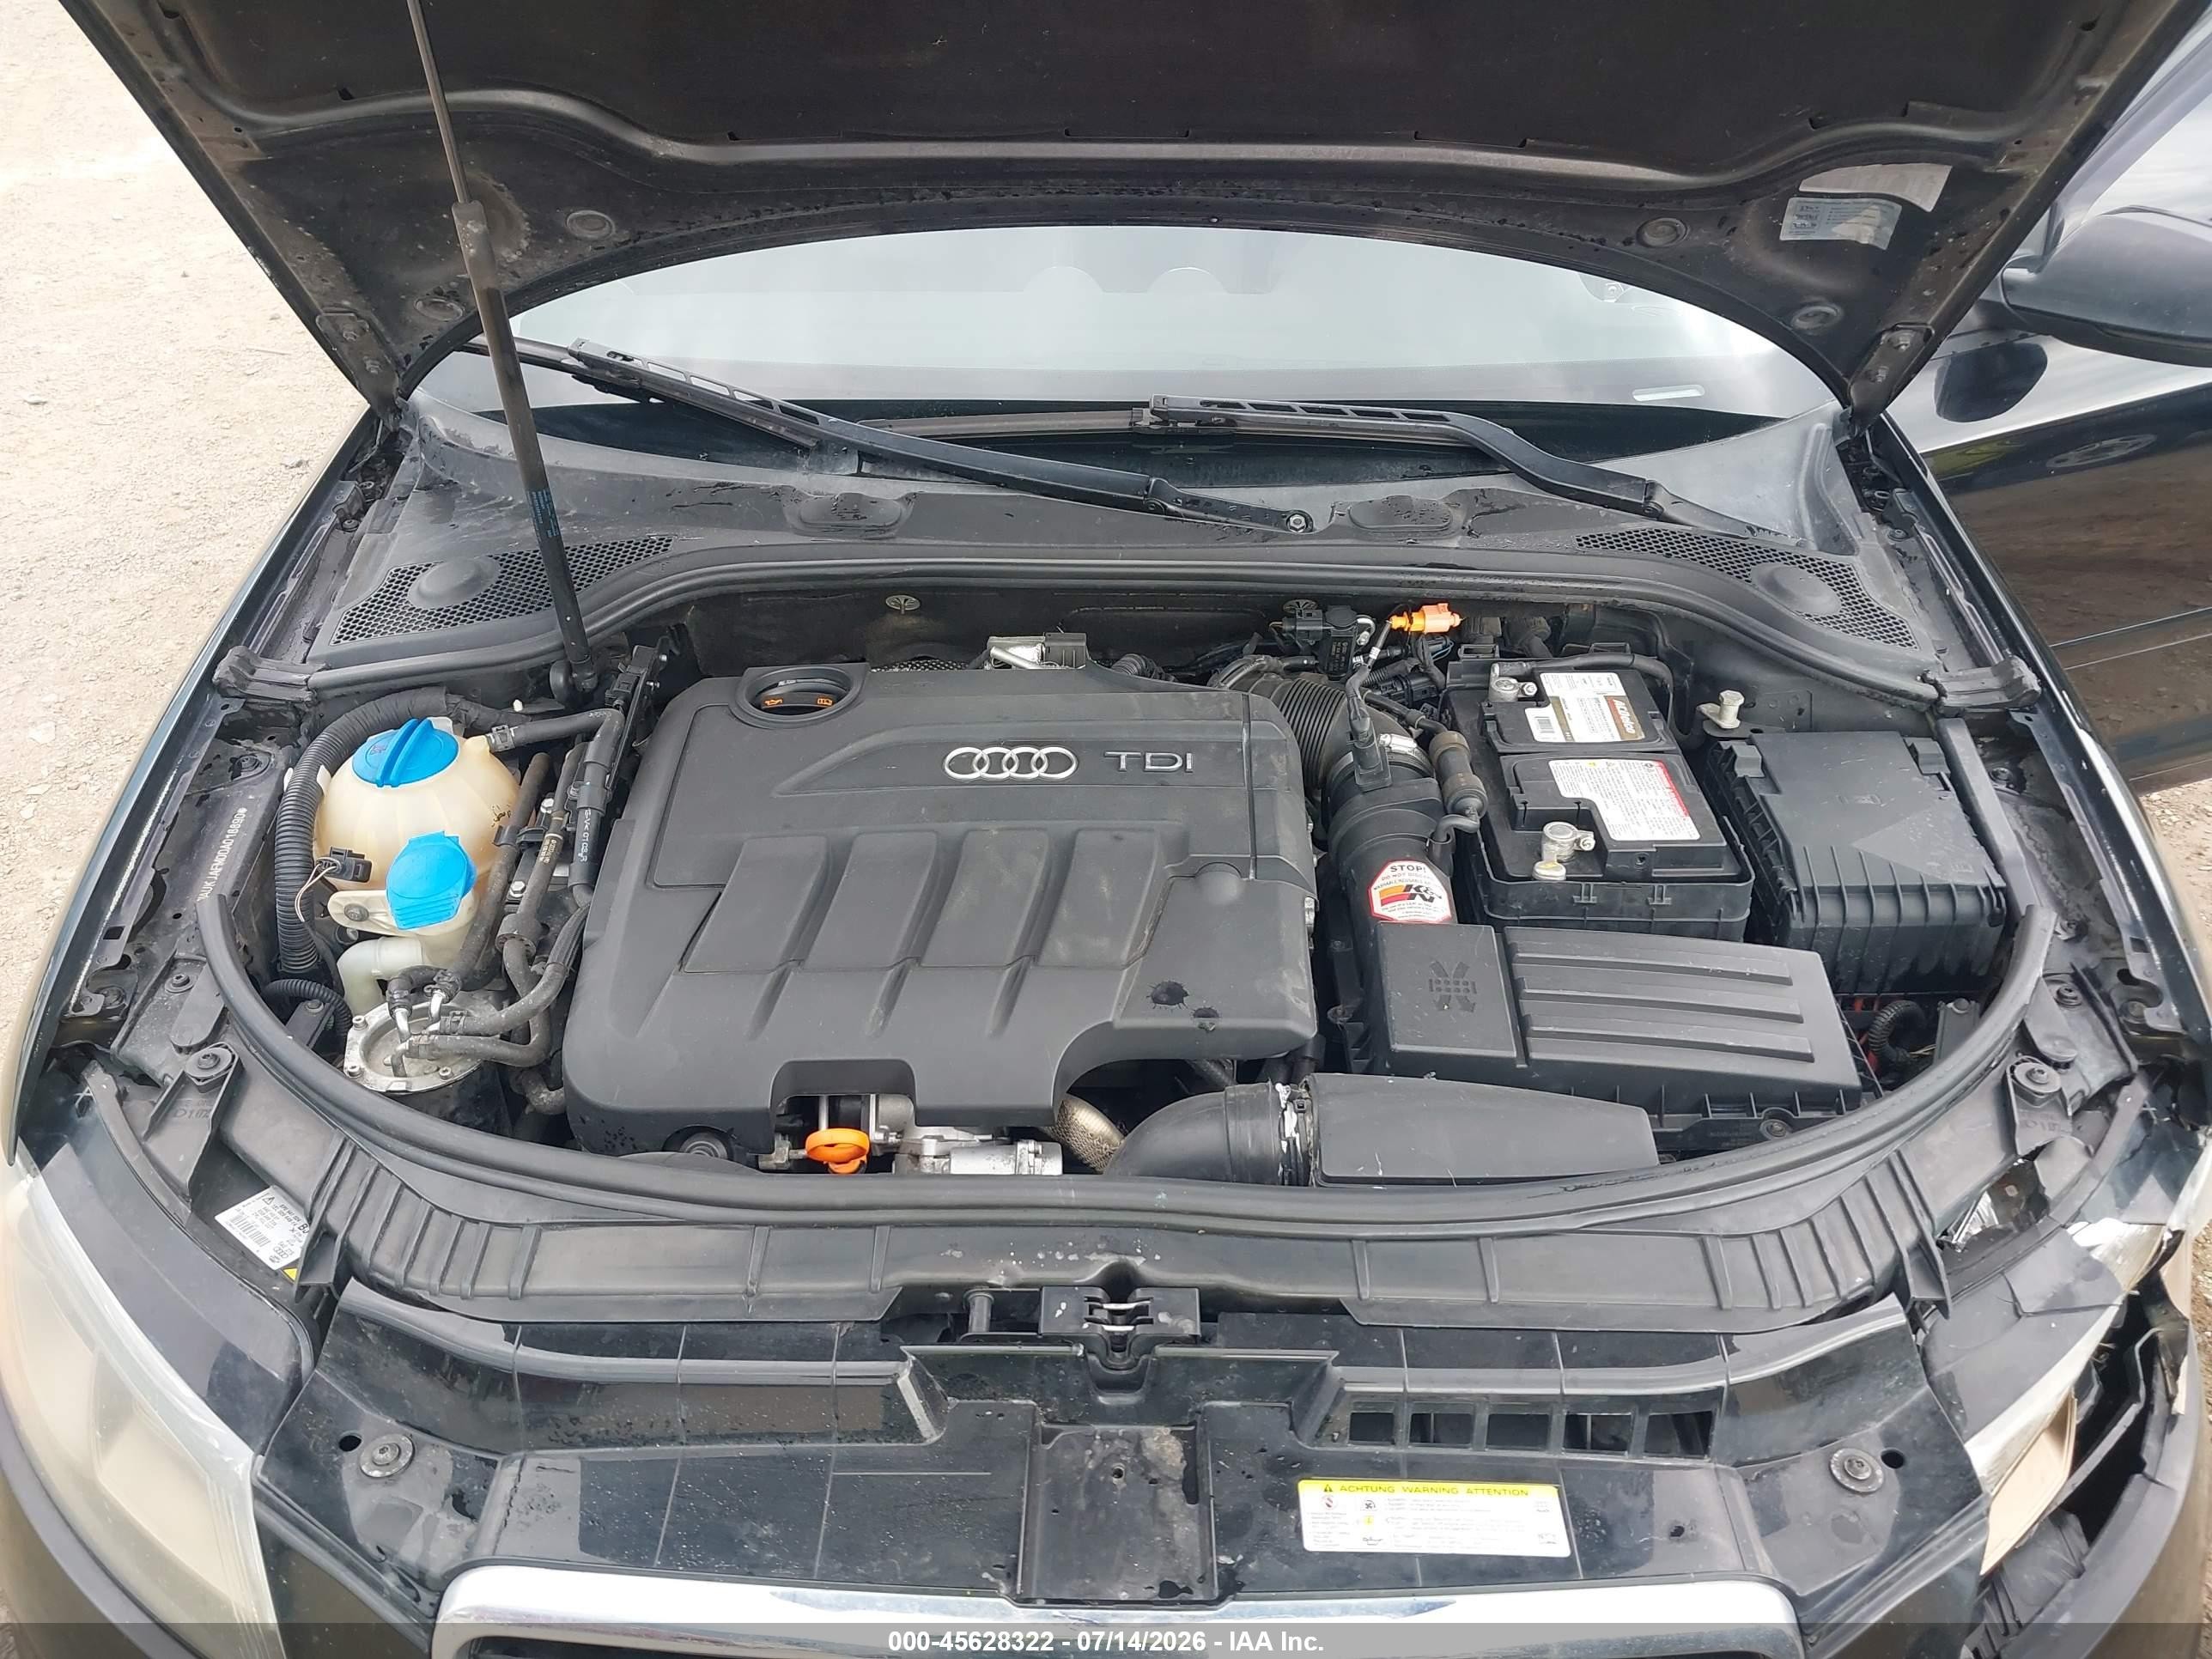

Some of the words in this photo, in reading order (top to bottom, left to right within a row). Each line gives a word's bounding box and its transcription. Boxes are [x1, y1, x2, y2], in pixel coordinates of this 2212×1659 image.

[1104, 751, 1194, 773] TDI
[1390, 865, 1426, 873] STOP!
[1403, 884, 1442, 902] K&N
[298, 1223, 309, 1234] BJ
[1466, 1487, 1528, 1496] ATTENTION
